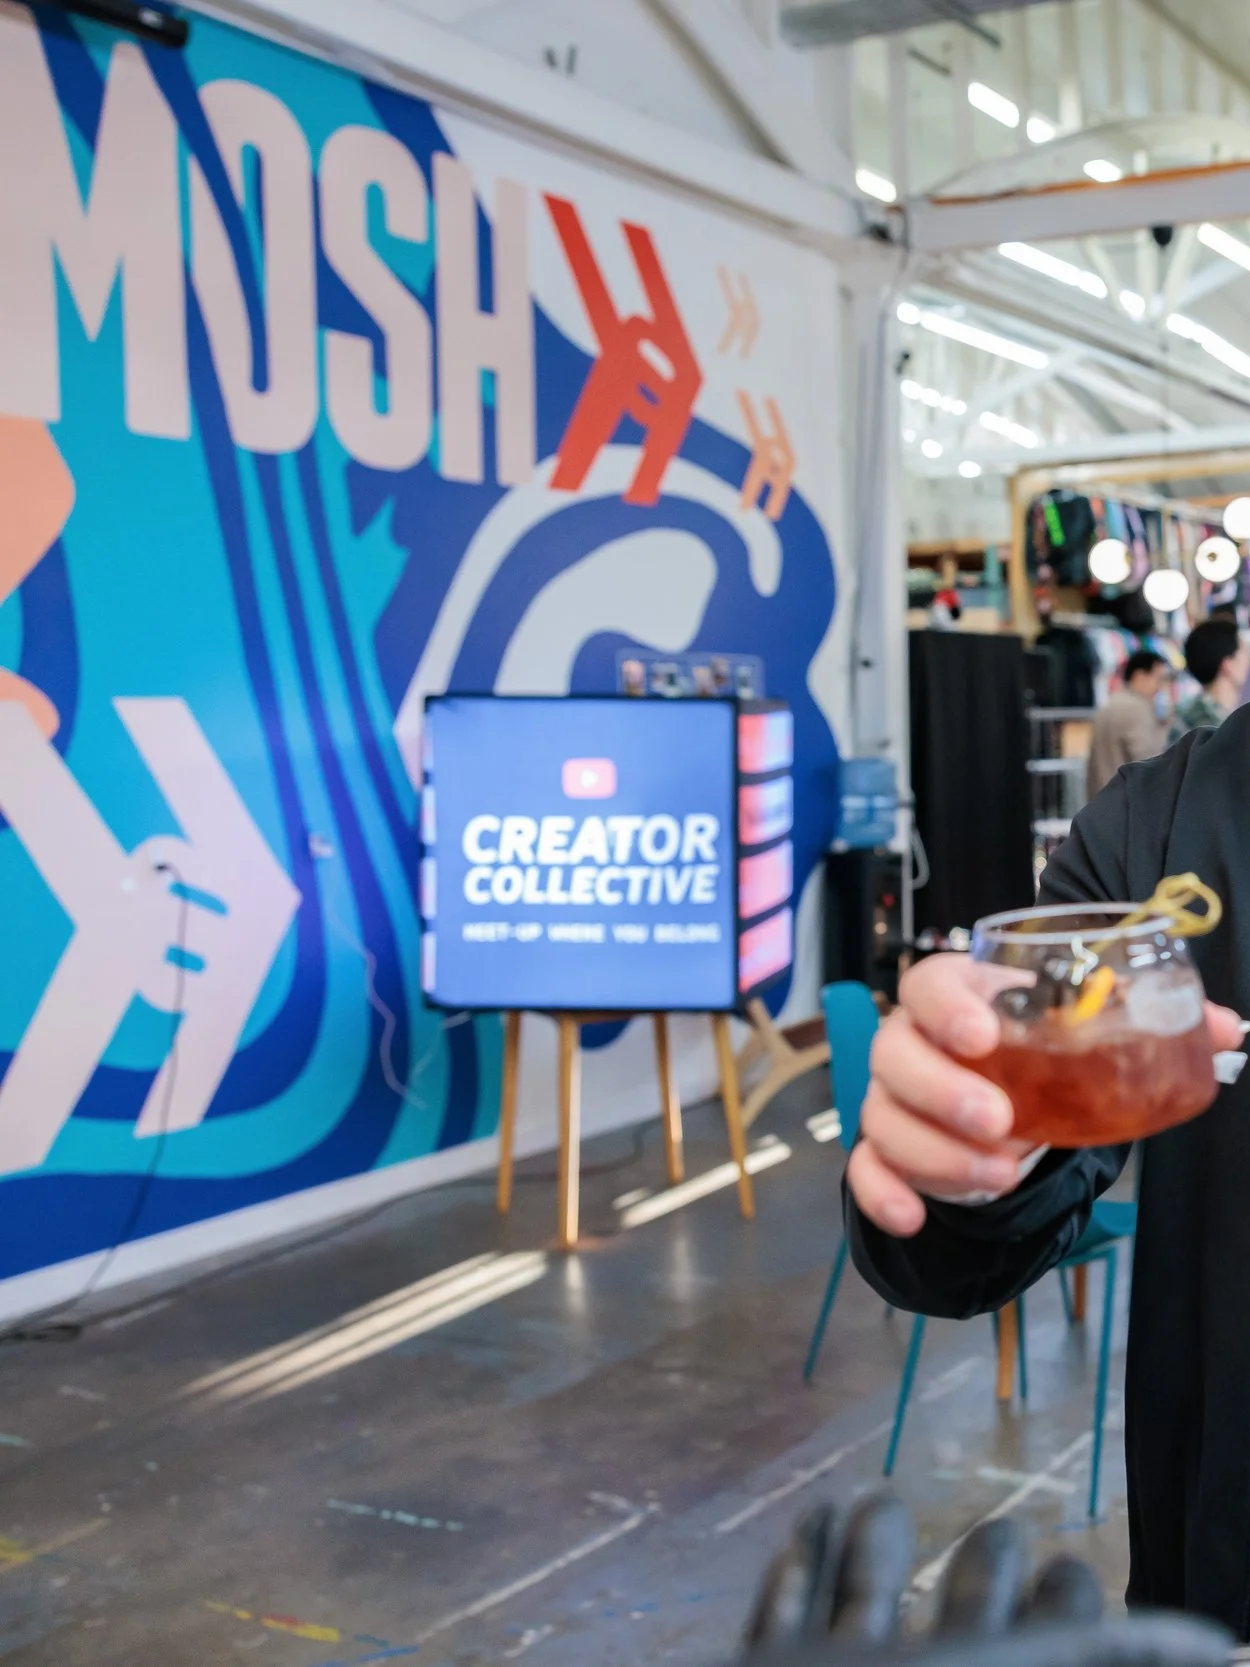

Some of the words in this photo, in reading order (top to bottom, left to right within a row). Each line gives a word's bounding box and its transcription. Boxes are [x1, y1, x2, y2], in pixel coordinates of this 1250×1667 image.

[0, 0, 539, 487] MOSH
[462, 813, 720, 865] CREATOR
[463, 864, 720, 905] COLLECTIVE
